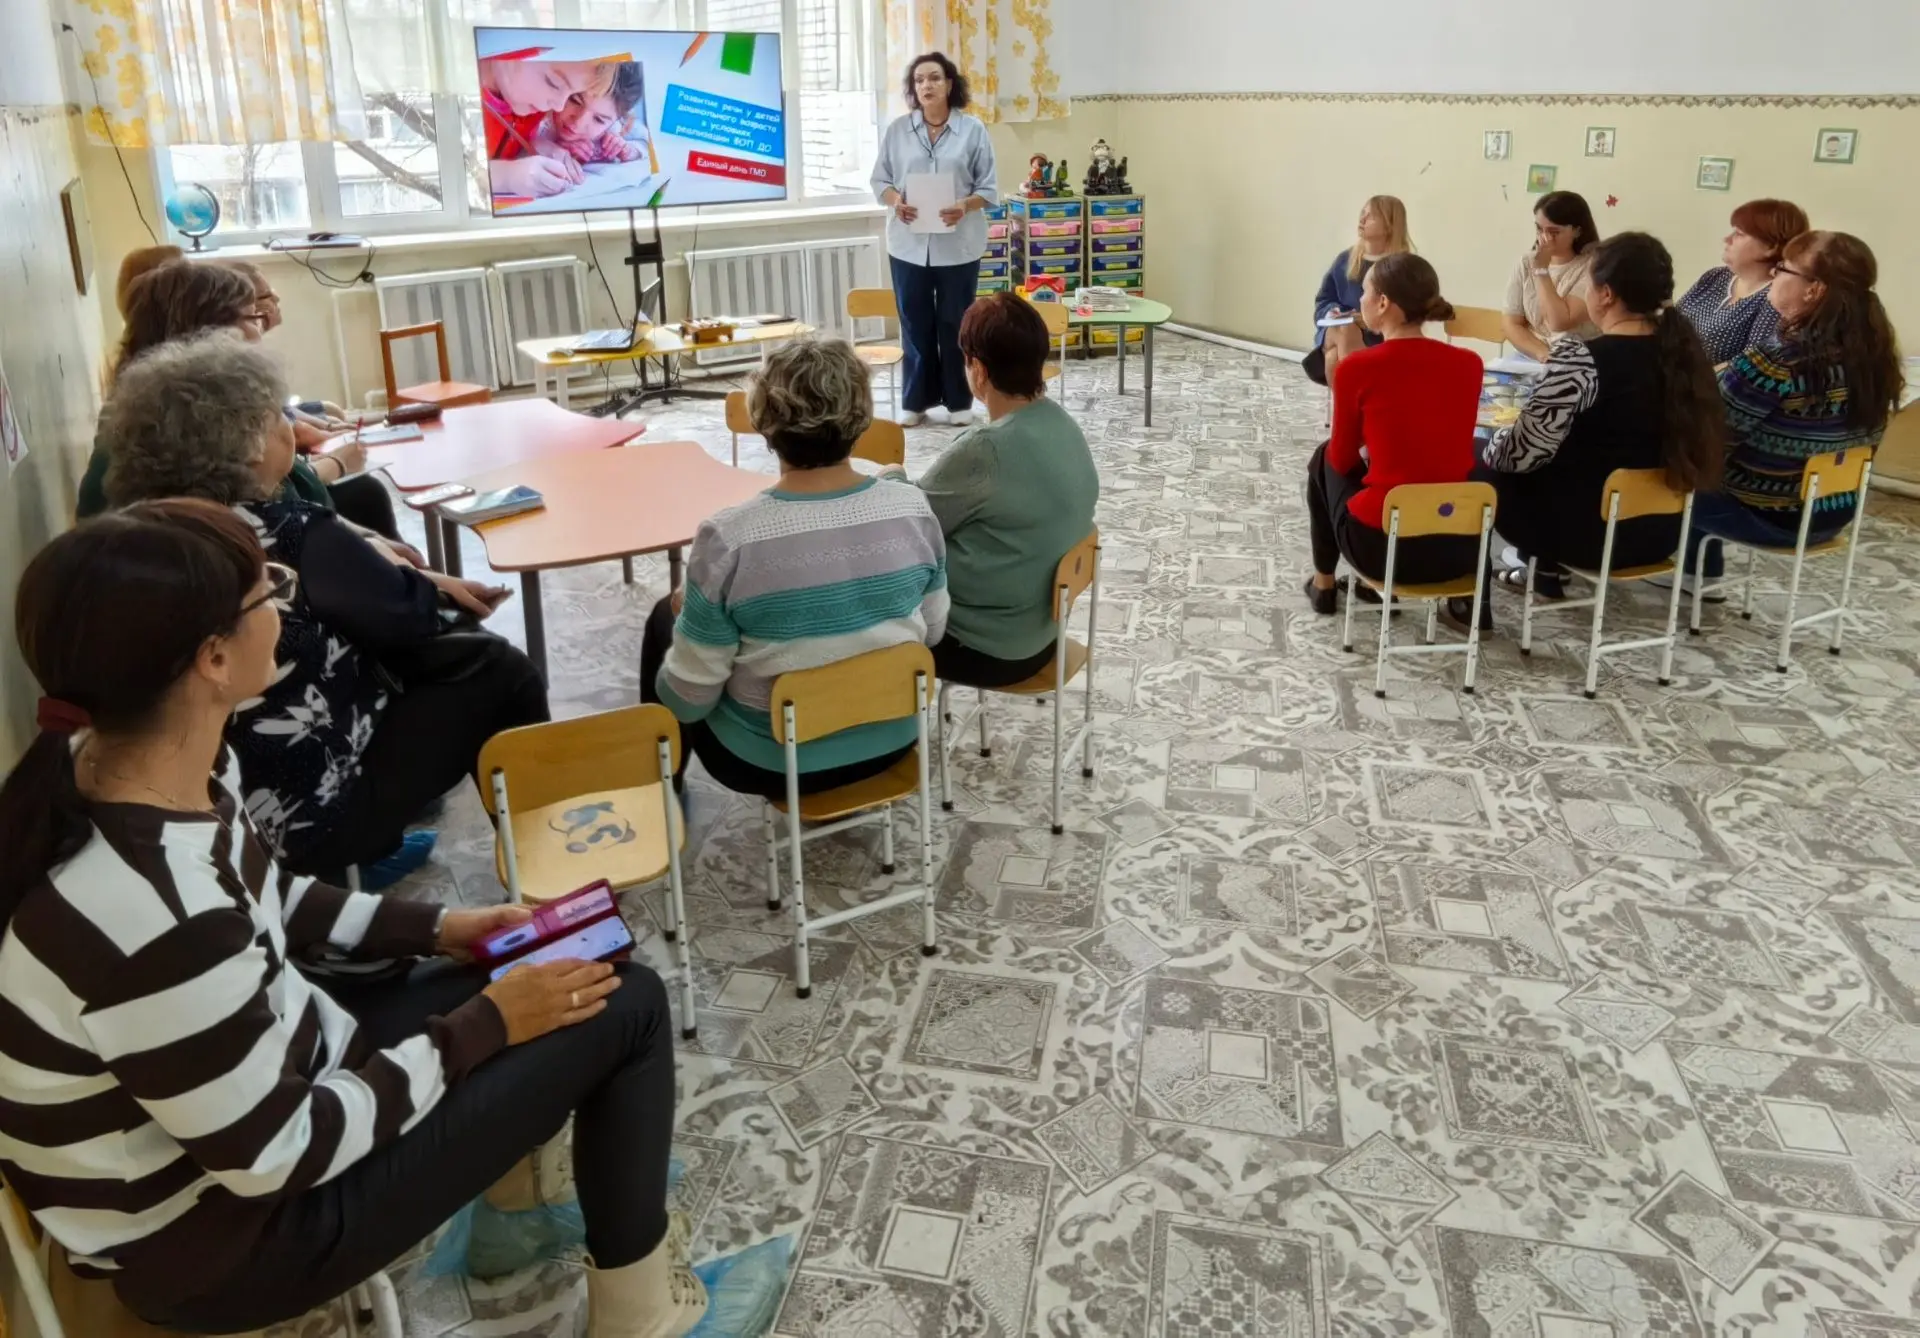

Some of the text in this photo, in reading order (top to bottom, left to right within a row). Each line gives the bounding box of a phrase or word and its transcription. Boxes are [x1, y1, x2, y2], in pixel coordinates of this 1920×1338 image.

[678, 91, 718, 107] Развитие
[722, 104, 743, 114] речи
[755, 112, 780, 122] детей
[677, 104, 777, 133] дошкольного возраста
[710, 122, 752, 138] условиях
[758, 142, 772, 153] ДО
[697, 158, 728, 170] Единый
[728, 165, 748, 175] день
